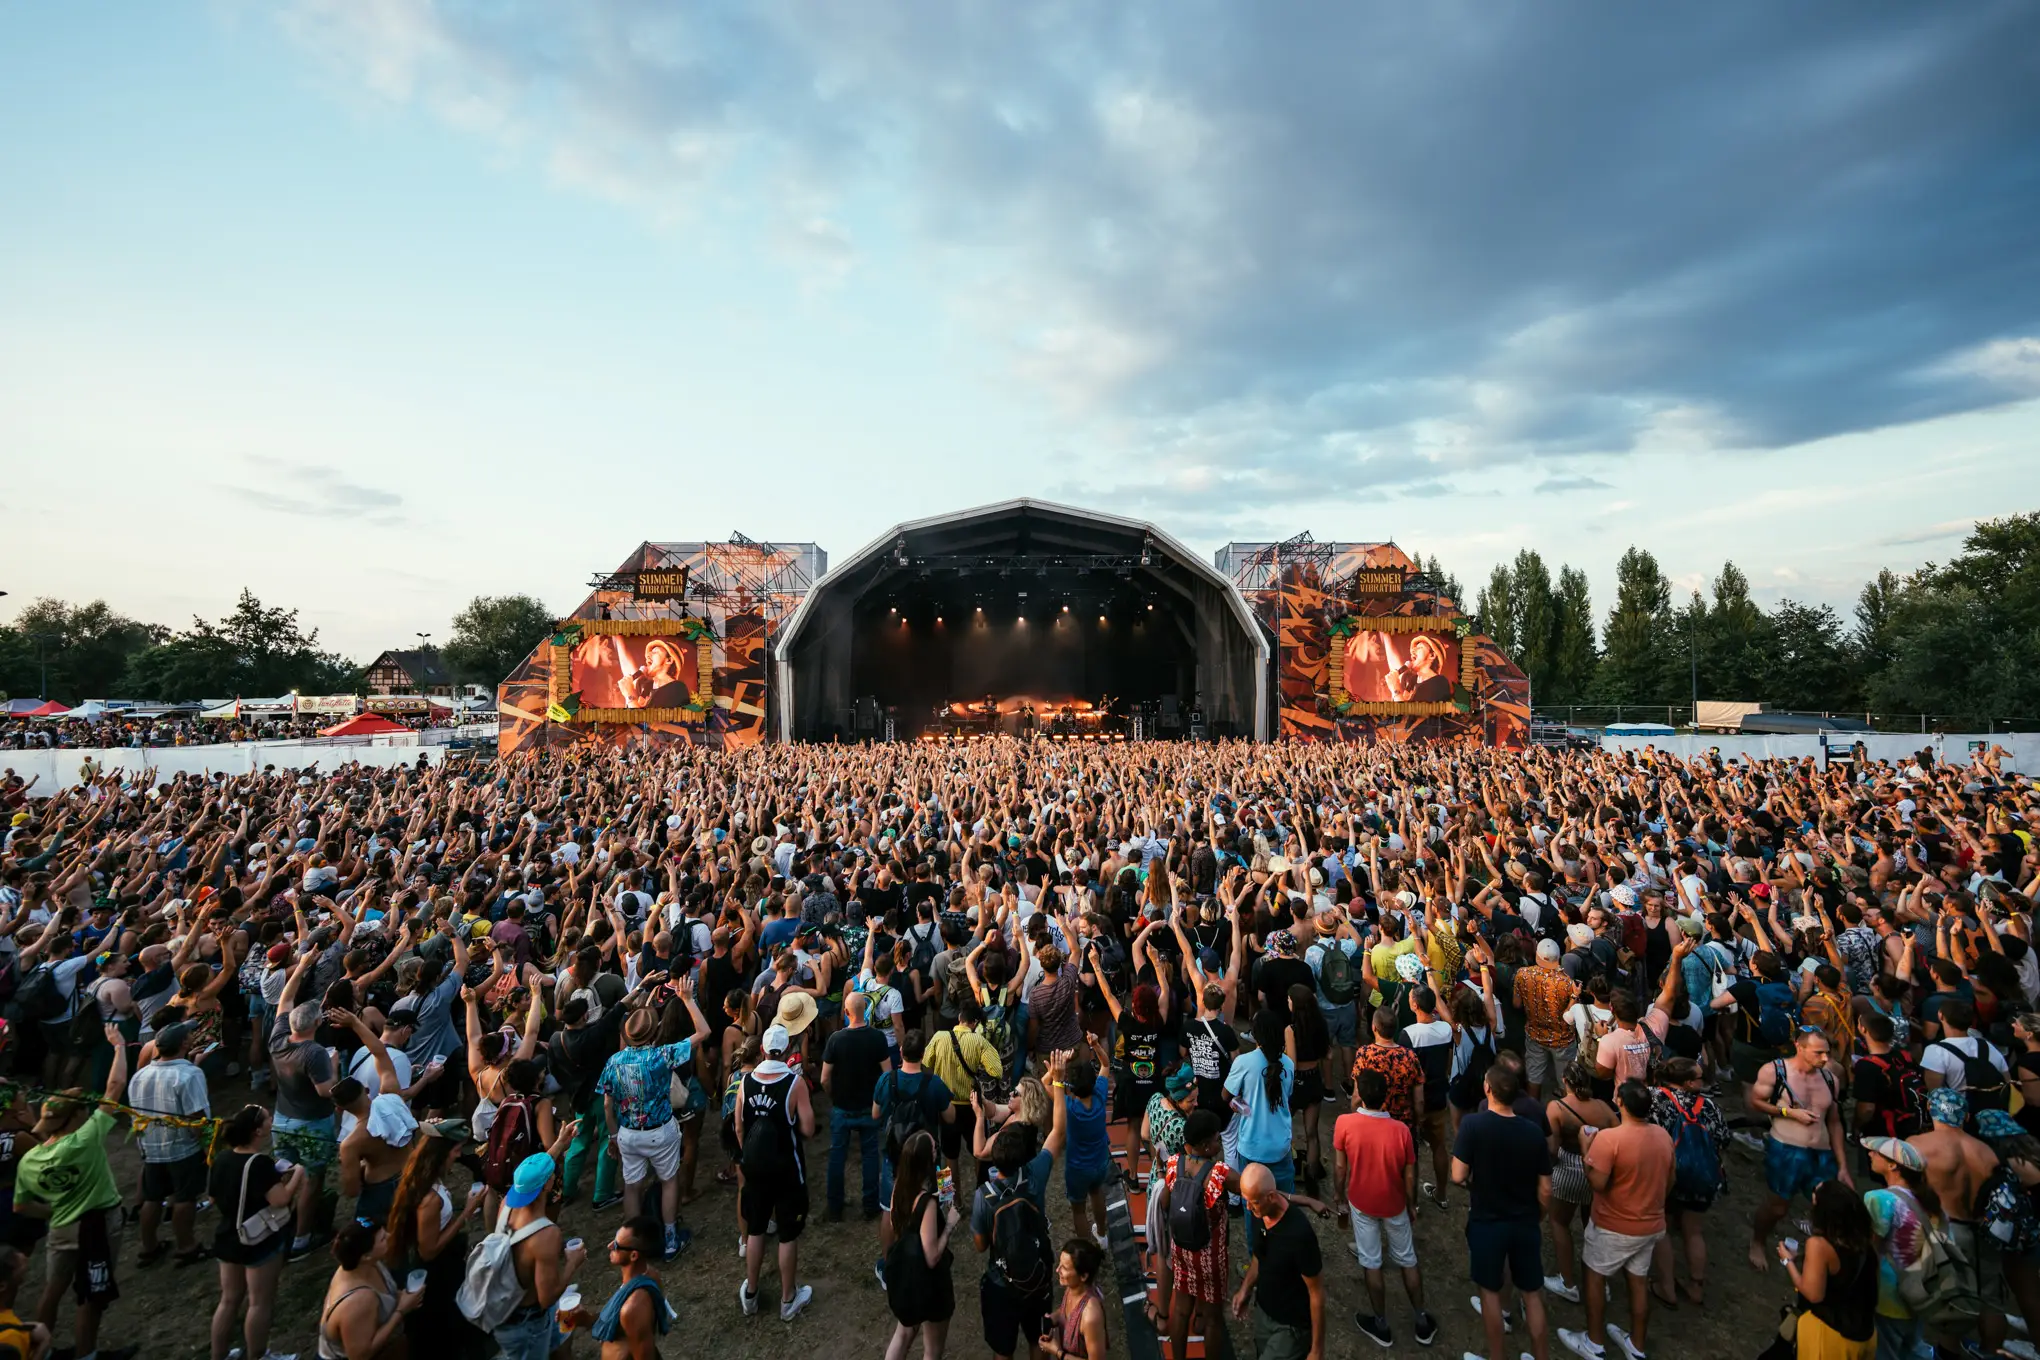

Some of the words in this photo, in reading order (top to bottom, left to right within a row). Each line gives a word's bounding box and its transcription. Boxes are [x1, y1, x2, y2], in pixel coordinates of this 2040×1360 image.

[639, 574, 683, 585] SUMMER
[1359, 573, 1401, 584] SUMMER
[639, 585, 683, 594] VIBRATION
[1359, 584, 1401, 593] VIBRATION
